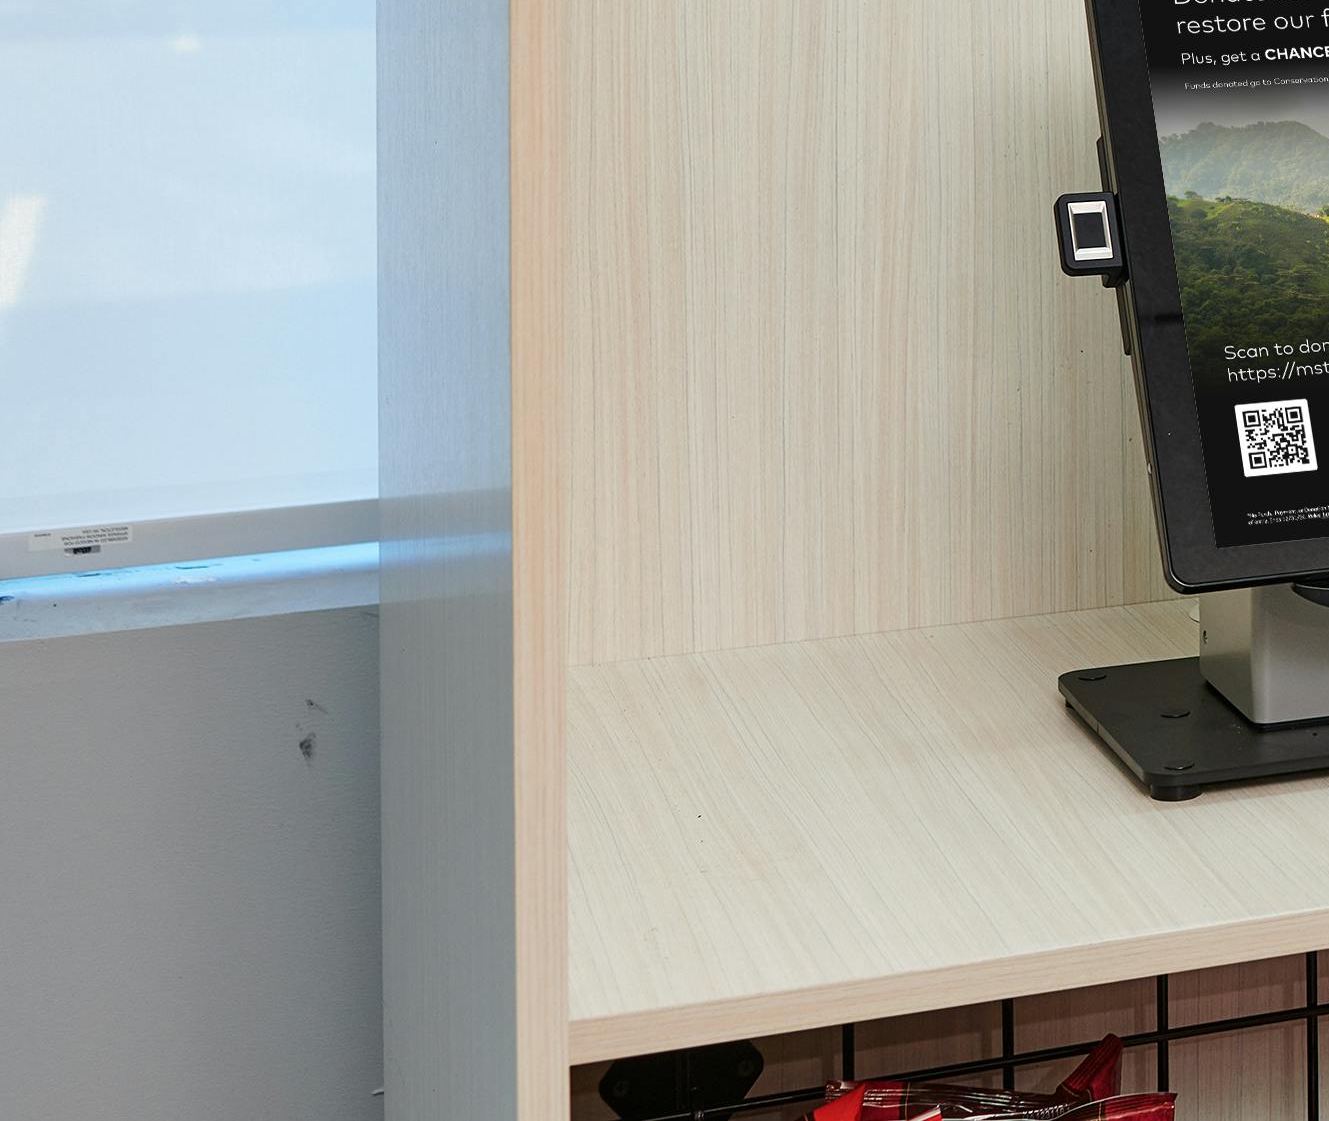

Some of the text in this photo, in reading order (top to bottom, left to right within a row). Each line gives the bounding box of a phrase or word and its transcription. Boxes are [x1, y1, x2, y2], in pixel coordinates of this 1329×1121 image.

[1176, 15, 1267, 35] restore
[1273, 12, 1315, 30] our
[1181, 52, 1218, 66] Plus,
[1221, 51, 1248, 66] get
[1250, 52, 1261, 62] a
[1184, 81, 1212, 90] Funds
[1212, 79, 1249, 90] donated
[1249, 79, 1262, 89] go
[1262, 77, 1273, 86] to
[1273, 74, 1329, 86] Conservation
[1224, 345, 1269, 360] Scan
[1273, 343, 1295, 357] to
